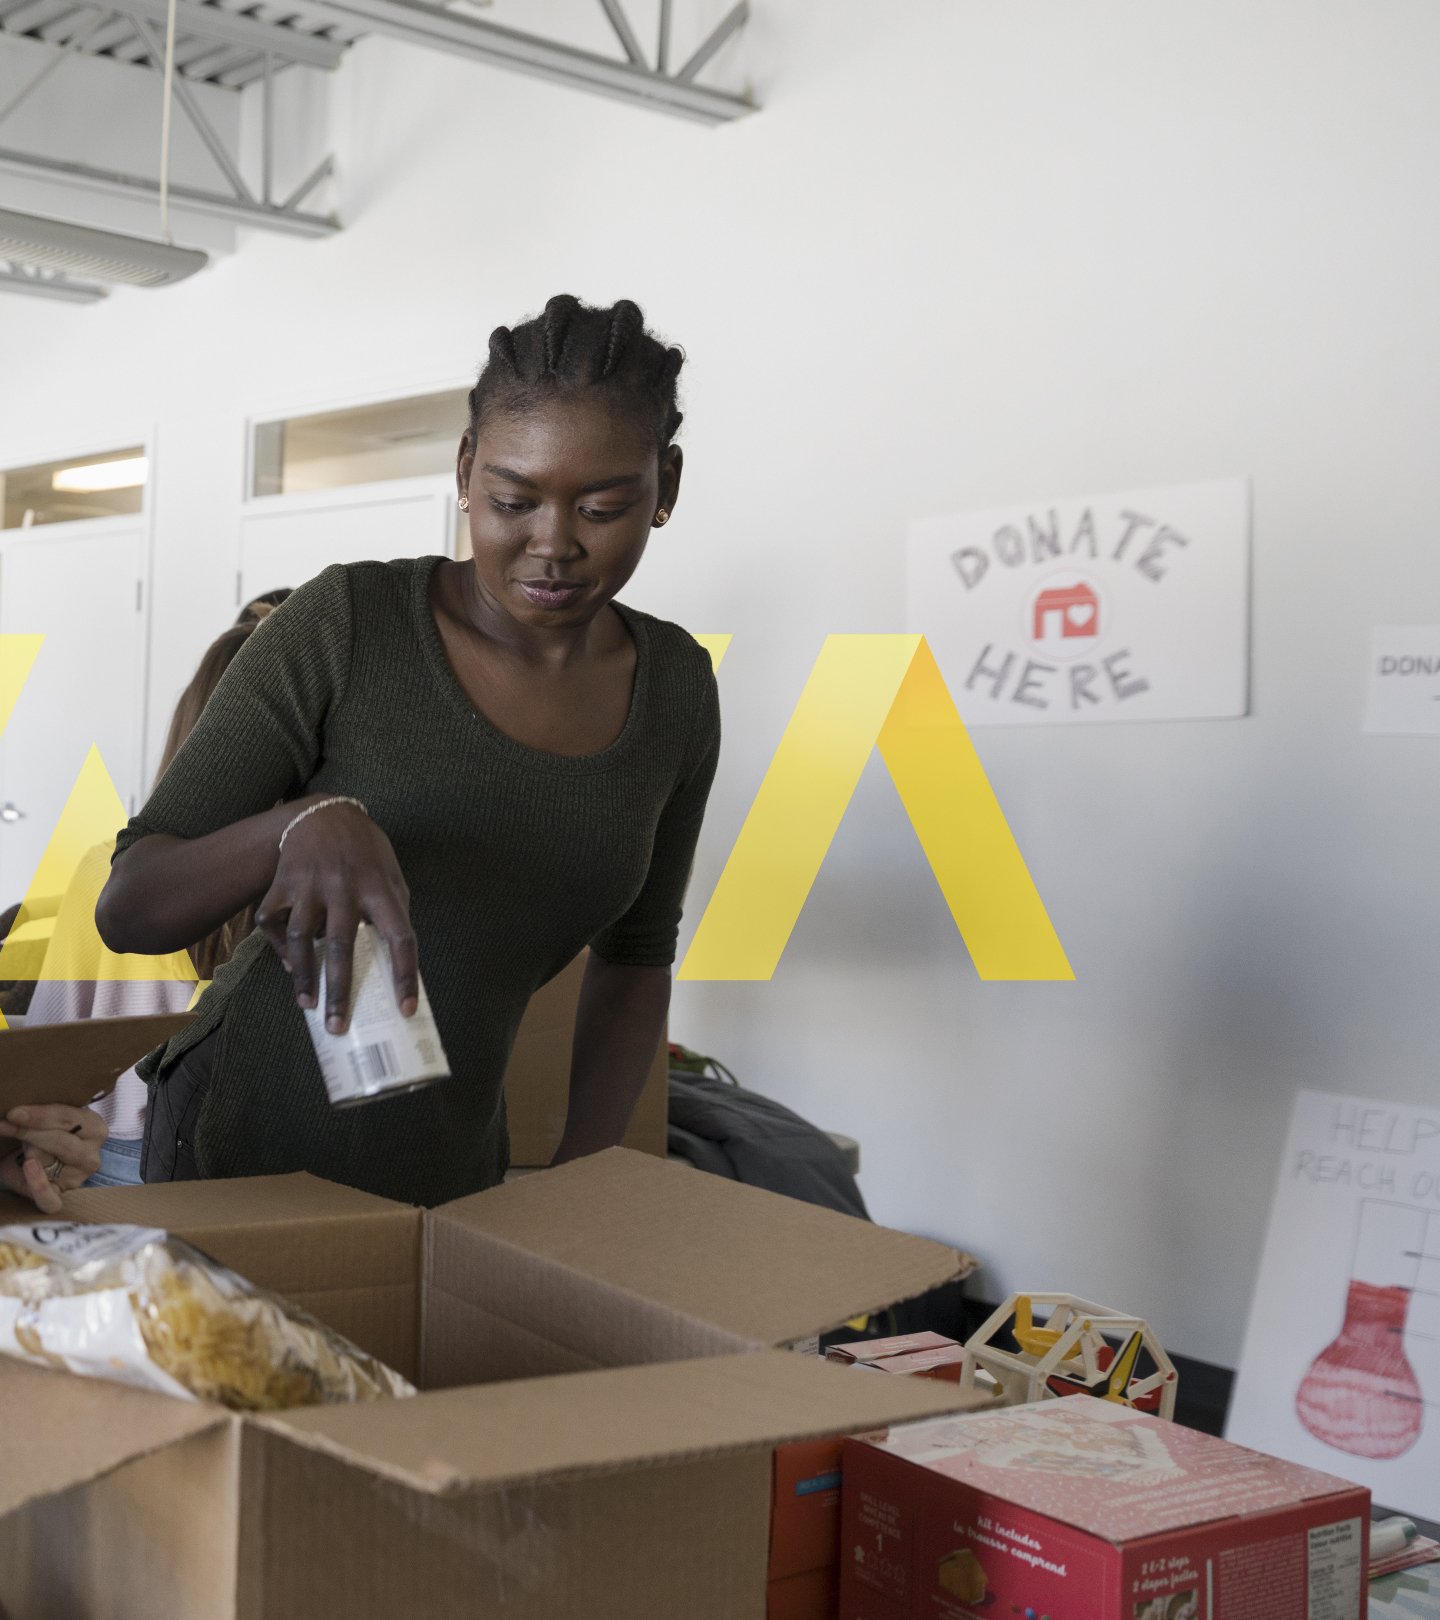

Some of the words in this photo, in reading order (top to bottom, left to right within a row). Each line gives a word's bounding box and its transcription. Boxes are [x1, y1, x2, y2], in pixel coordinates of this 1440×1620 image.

[950, 507, 1192, 591] DONATE
[965, 643, 1150, 711] HERE
[1331, 1102, 1440, 1155] HELP
[1294, 1149, 1396, 1195] REACH
[953, 1520, 965, 1535] la
[967, 1526, 1009, 1553] trousse
[1010, 1547, 1068, 1577] comprend
[977, 1515, 993, 1531] kit
[994, 1522, 1042, 1551] includes
[1167, 1556, 1190, 1570] steps
